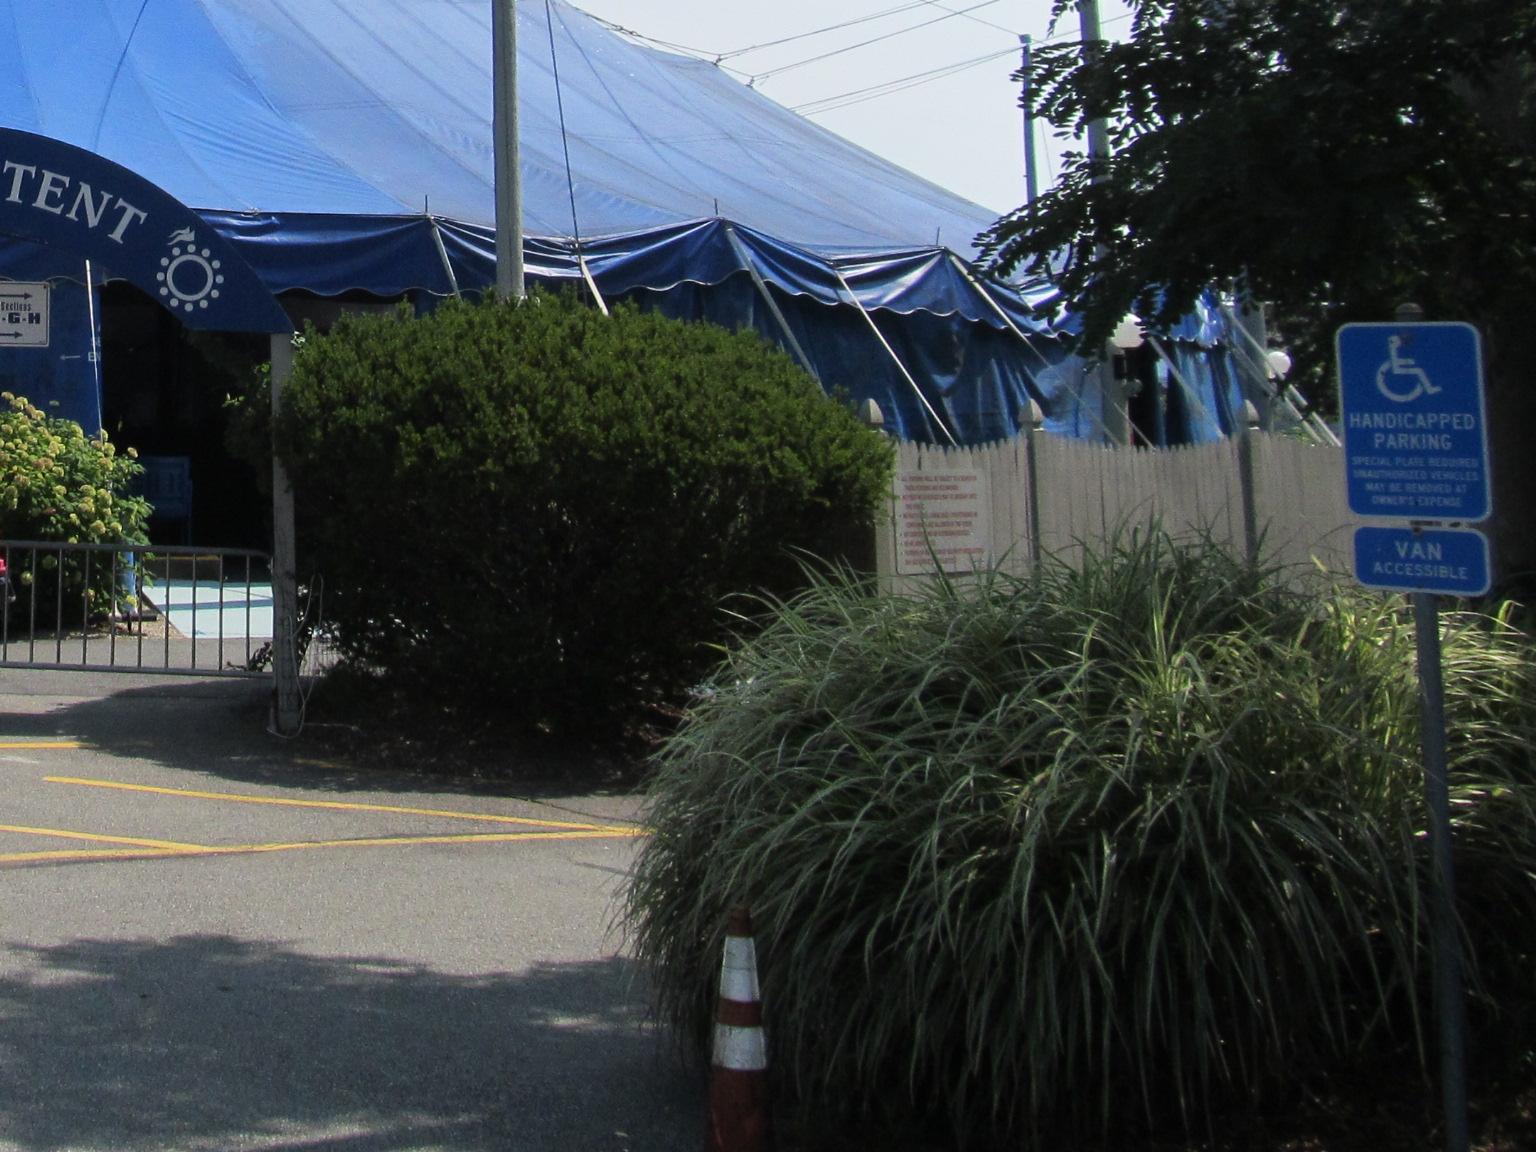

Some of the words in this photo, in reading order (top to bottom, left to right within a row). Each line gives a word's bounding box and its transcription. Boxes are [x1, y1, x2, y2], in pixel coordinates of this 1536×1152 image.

[2, 159, 148, 245] TENT
[0, 302, 32, 312] Sections
[1349, 412, 1476, 430] HANDICAPPED
[1373, 432, 1453, 450] PARKING
[1394, 540, 1442, 561] VAN
[1372, 561, 1469, 580] ACCESSIBLE
